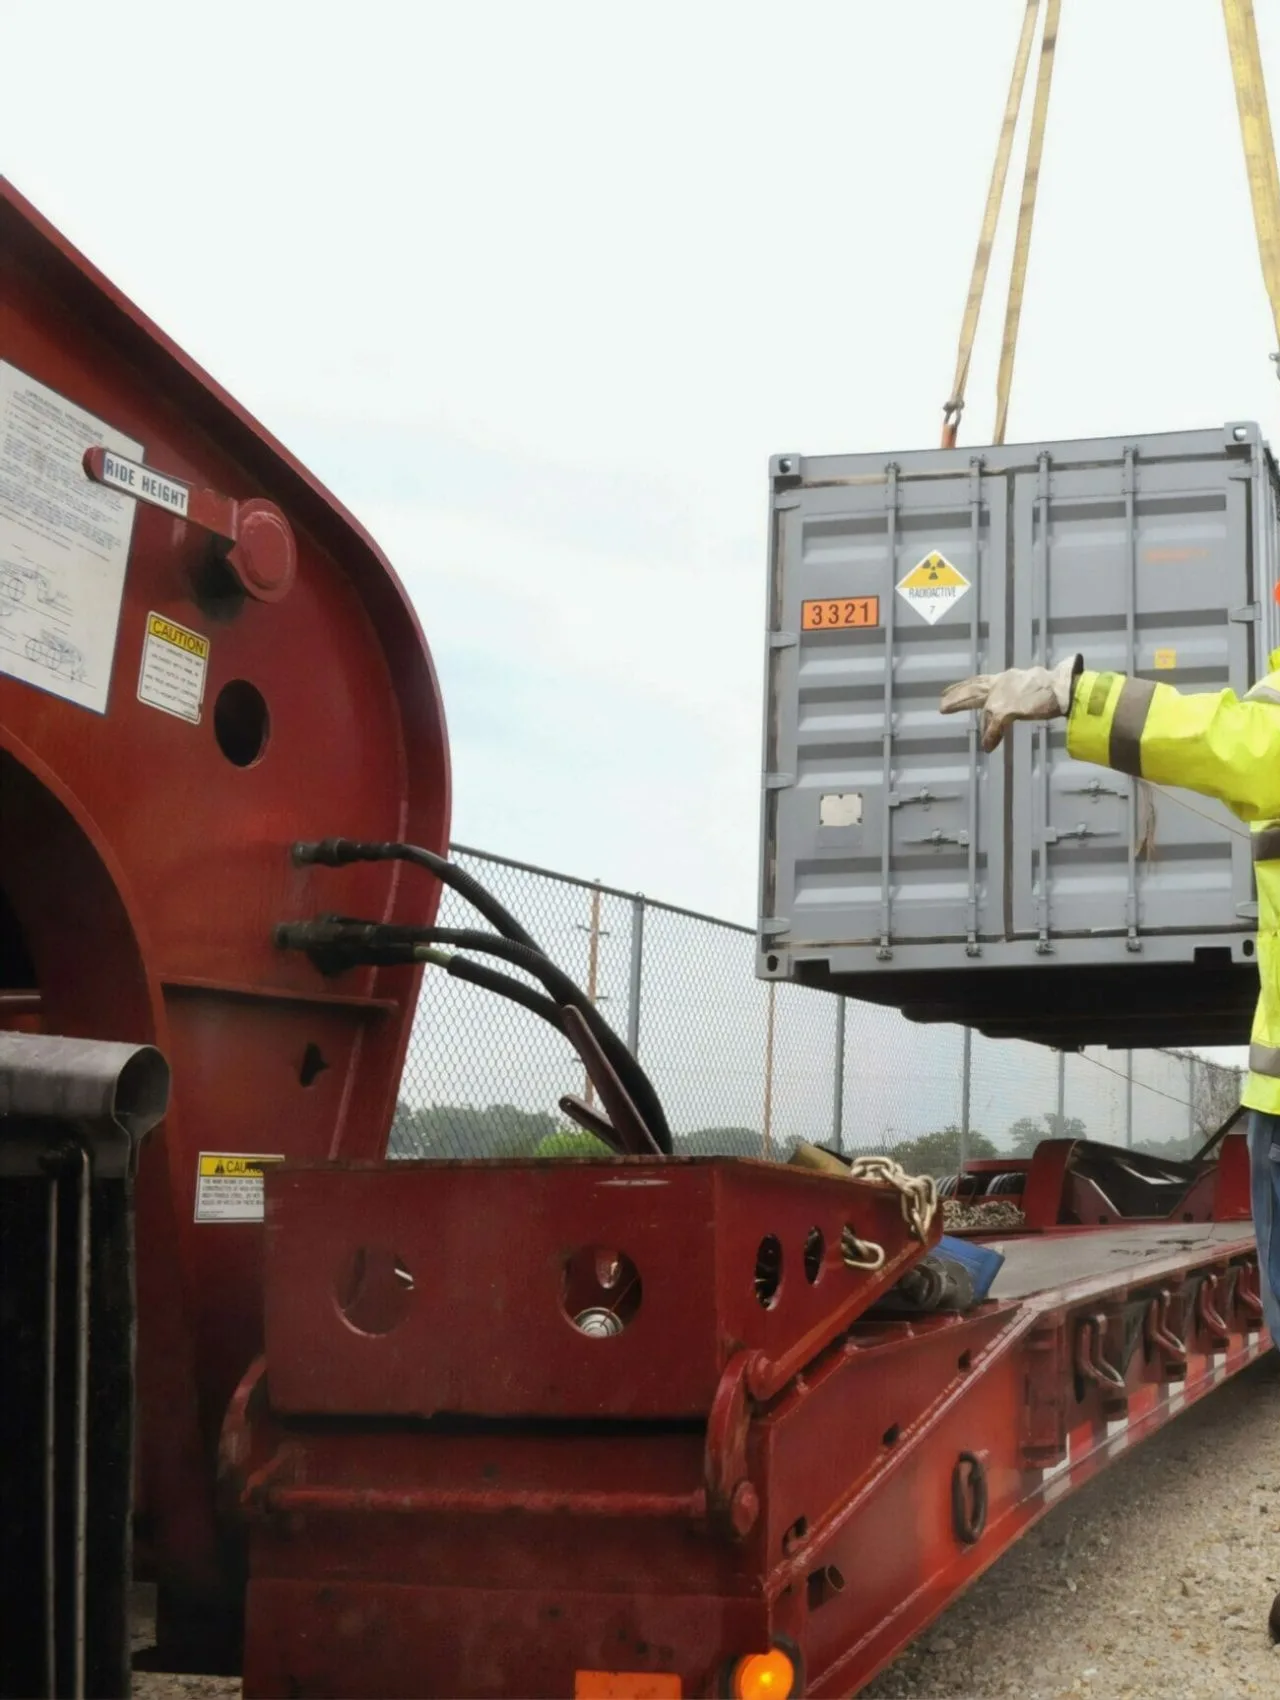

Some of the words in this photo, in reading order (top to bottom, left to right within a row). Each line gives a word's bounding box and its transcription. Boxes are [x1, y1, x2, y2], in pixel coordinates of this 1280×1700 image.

[105, 458, 135, 486] RIDE
[142, 475, 186, 509] HEIGHT
[908, 586, 956, 598] RADIOACTIVE
[812, 601, 868, 626] 3321
[929, 605, 936, 614] 7
[153, 619, 204, 654] CAUTION
